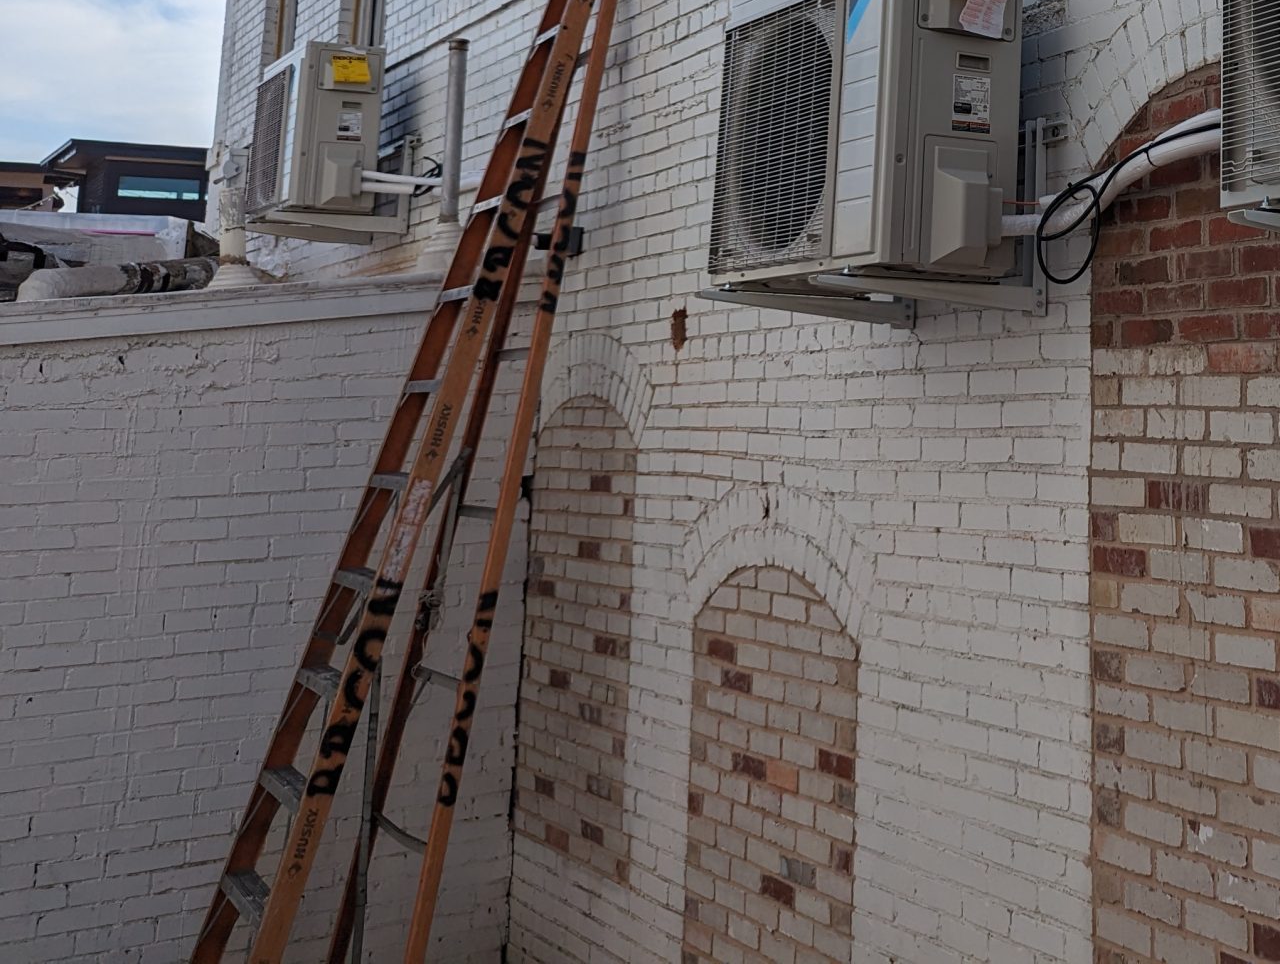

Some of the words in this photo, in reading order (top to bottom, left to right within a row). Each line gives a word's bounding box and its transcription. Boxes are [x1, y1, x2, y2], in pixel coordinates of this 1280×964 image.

[548, 61, 566, 98] HUSKY
[431, 403, 453, 448] HUSKY
[293, 808, 320, 860] HUSKY
